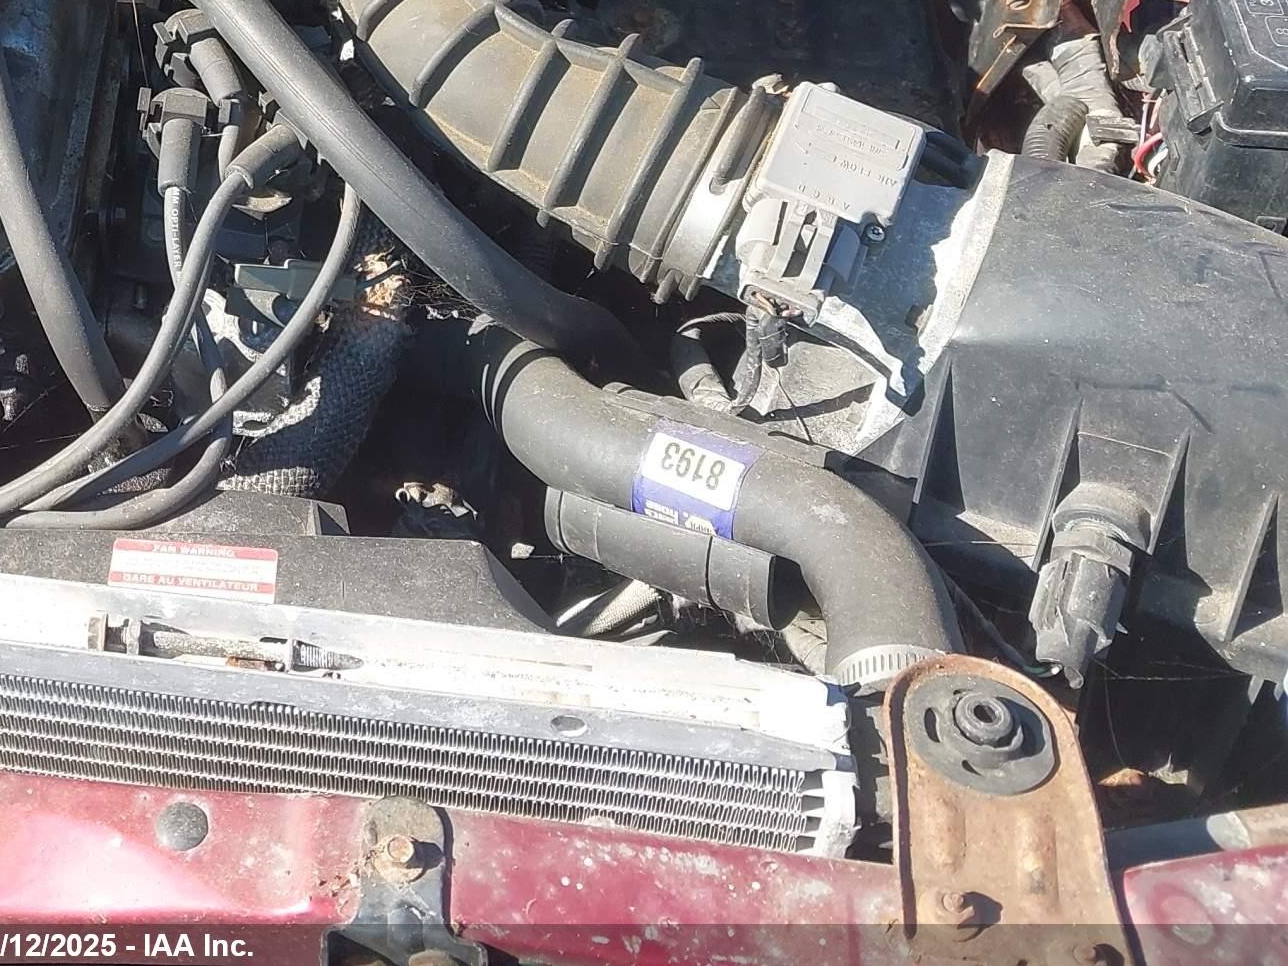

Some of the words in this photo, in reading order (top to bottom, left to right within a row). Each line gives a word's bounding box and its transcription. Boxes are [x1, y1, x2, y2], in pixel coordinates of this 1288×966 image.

[171, 209, 182, 267] OPTI-LAYER
[661, 442, 726, 491] 8193
[151, 544, 177, 555] FAN
[179, 546, 237, 558] WARNING
[155, 576, 175, 585] AU
[178, 578, 259, 591] VENTILATEUR
